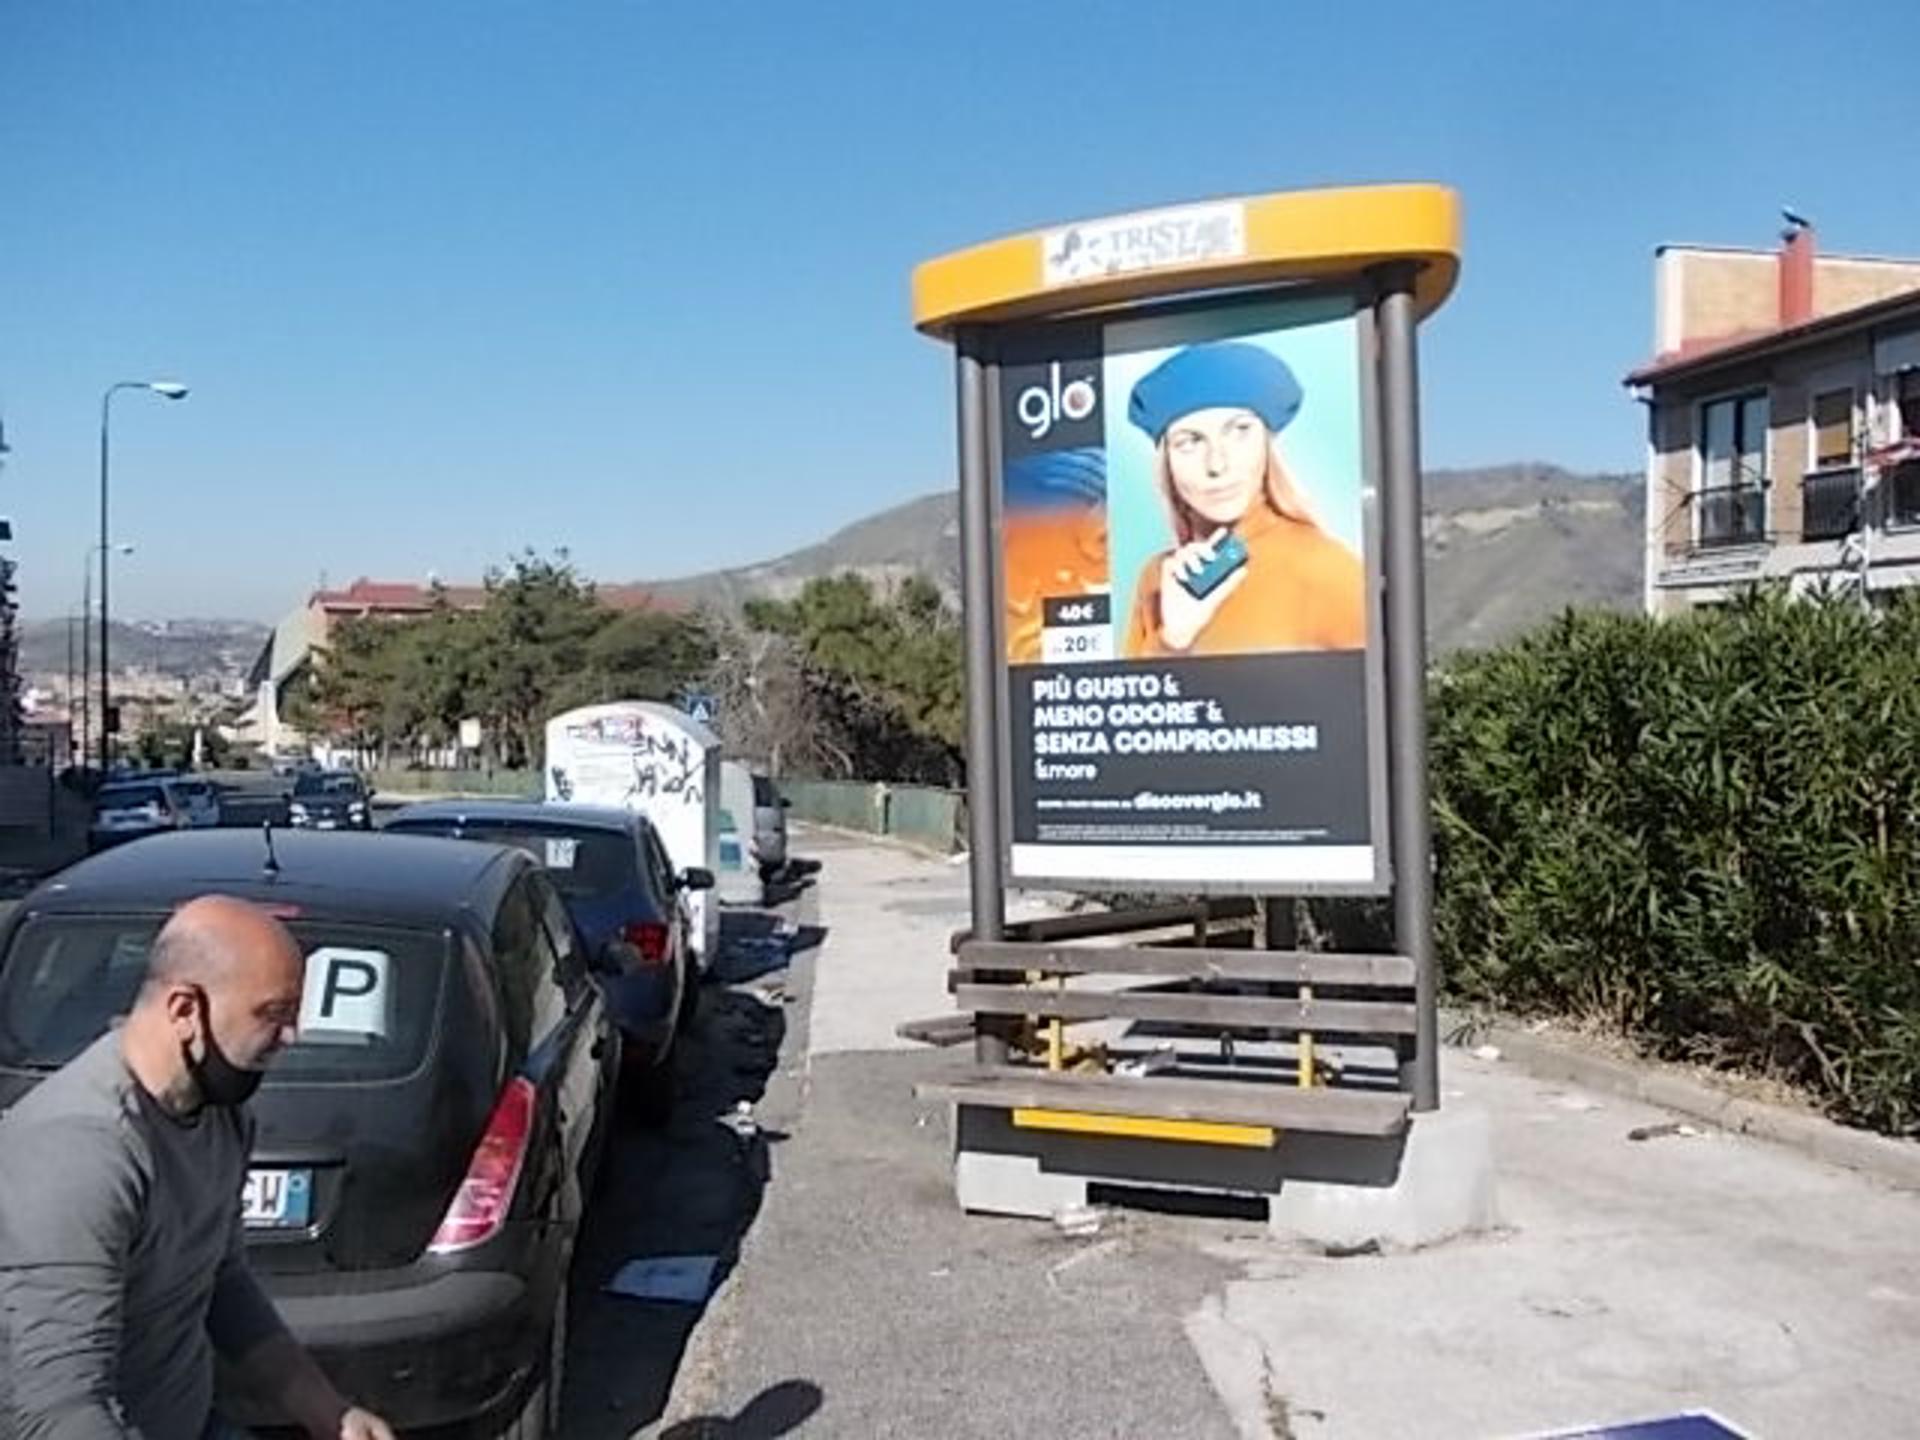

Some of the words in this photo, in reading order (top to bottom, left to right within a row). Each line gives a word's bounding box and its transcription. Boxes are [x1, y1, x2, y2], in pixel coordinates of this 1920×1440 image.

[1018, 361, 1096, 438] glo
[1034, 675, 1071, 701] PIÙ
[1075, 677, 1159, 699] GUSTO
[1164, 674, 1180, 696] &
[1035, 704, 1104, 727] MENO
[1206, 701, 1224, 722] &
[1034, 732, 1110, 754] SENZA
[1114, 726, 1318, 752] COMPROMESSI
[320, 958, 377, 1018] P
